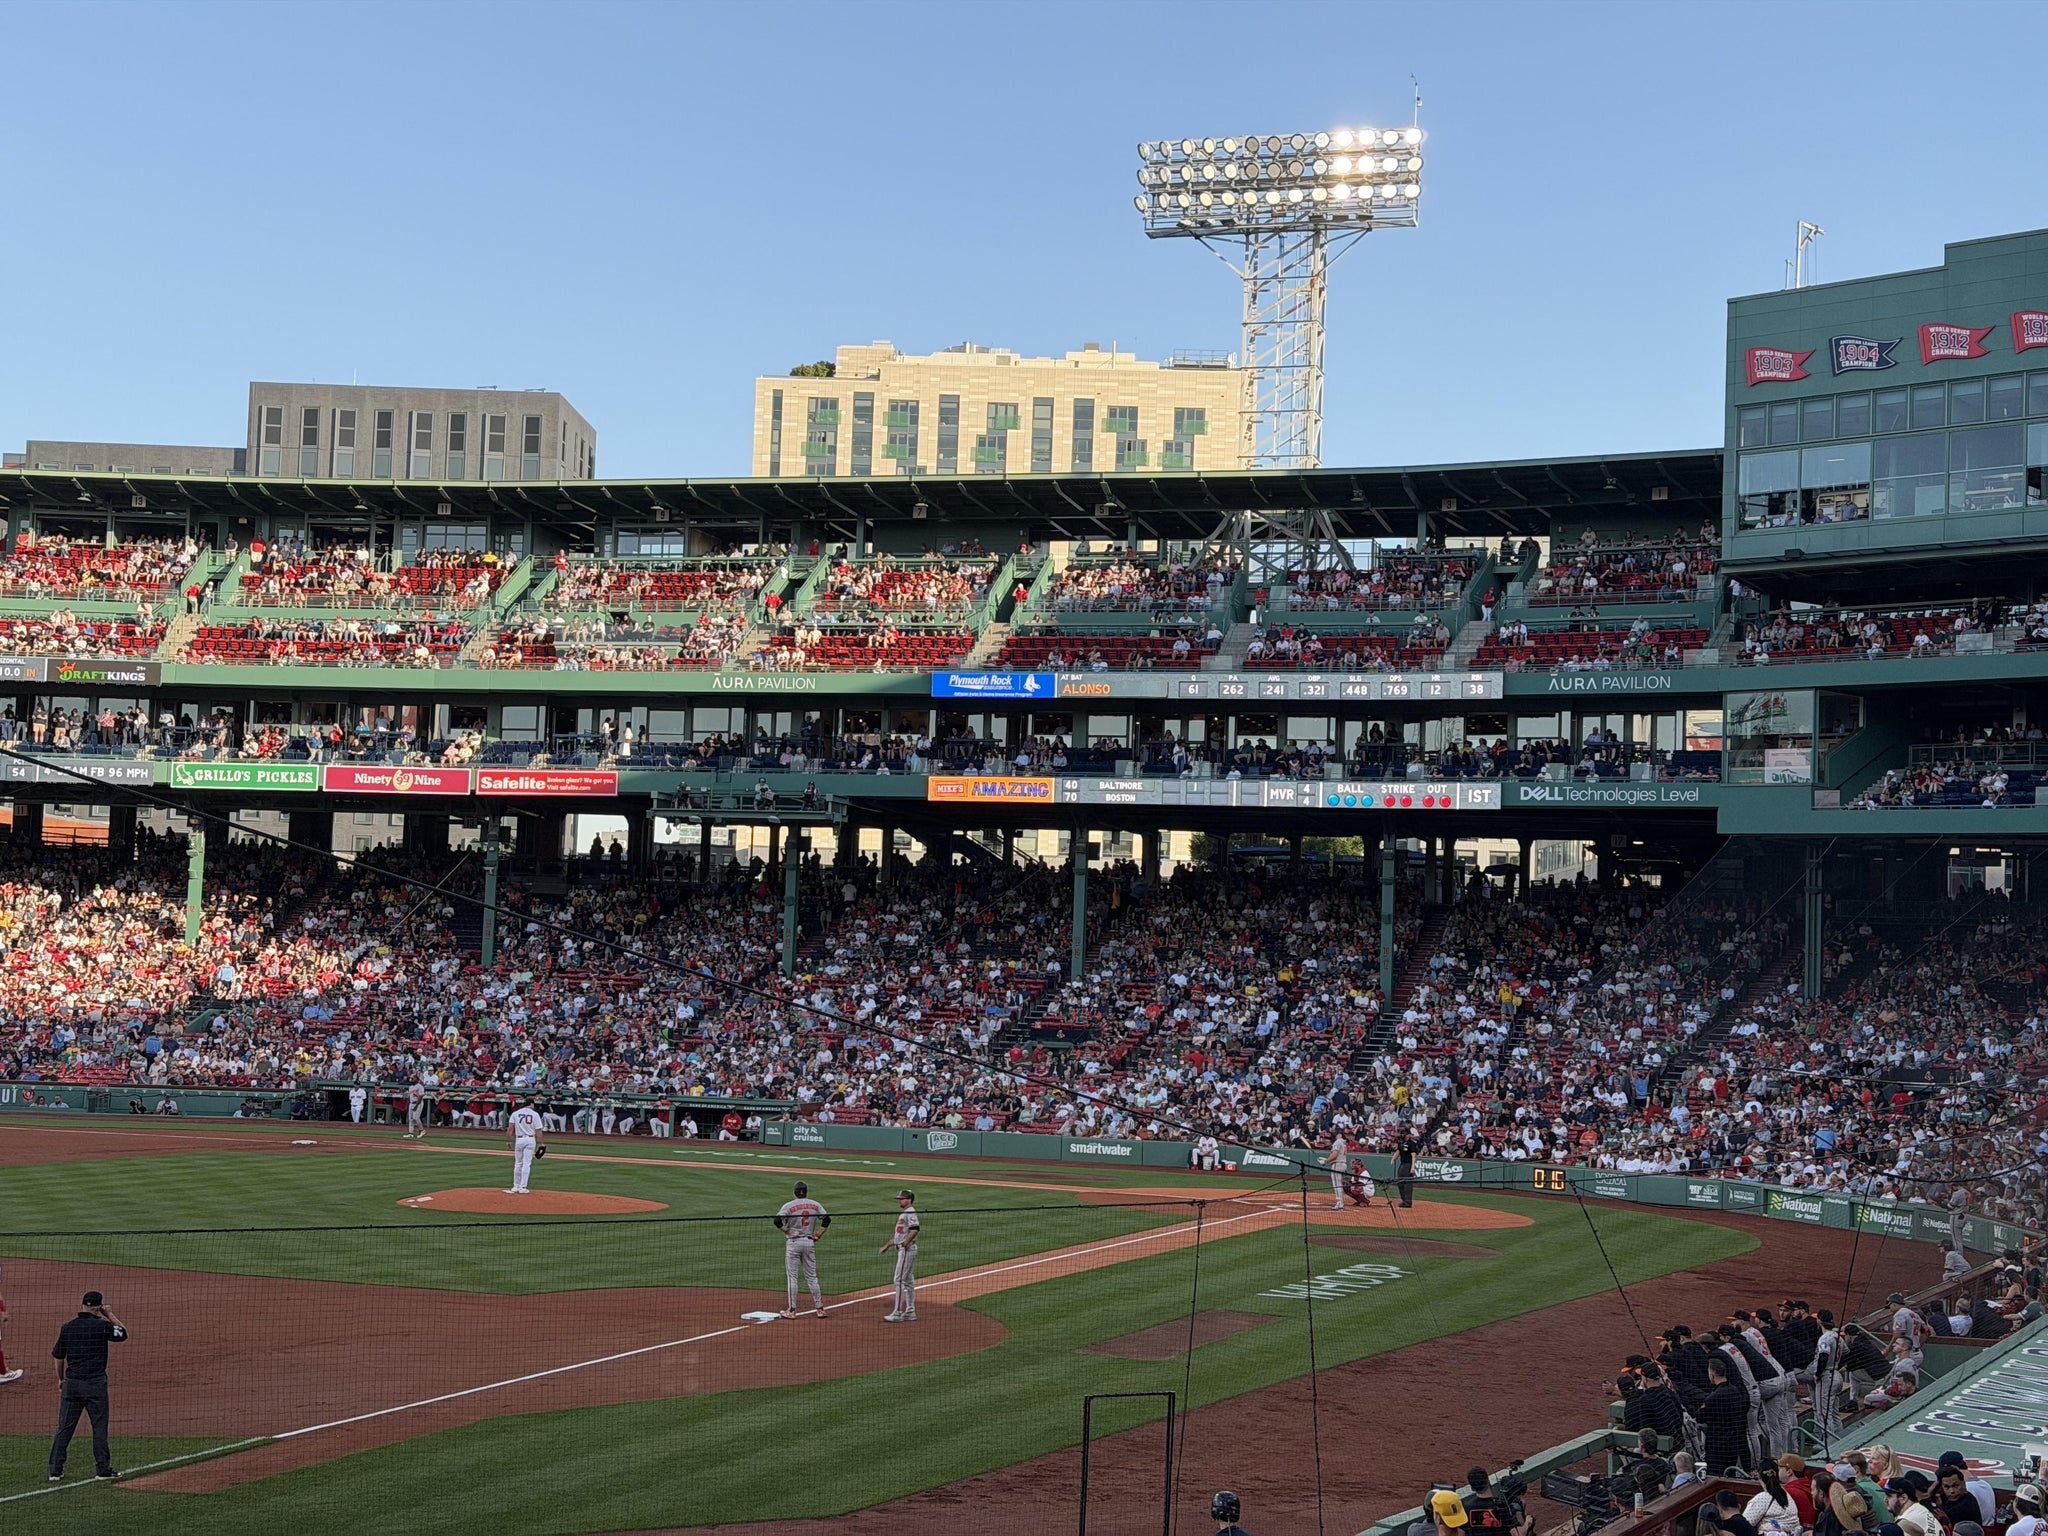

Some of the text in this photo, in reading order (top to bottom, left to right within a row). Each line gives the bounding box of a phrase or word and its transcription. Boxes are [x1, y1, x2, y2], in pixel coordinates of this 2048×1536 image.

[2023, 320, 2048, 338] 191
[1931, 332, 1970, 349] 1912
[1838, 344, 1880, 362] 1904
[1931, 348, 1969, 356] CHAMPIONS
[1754, 356, 1794, 373] 1903
[1756, 371, 1790, 379] CHAMPIONS
[26, 668, 36, 677] IN
[60, 669, 146, 681] DRAFTKINGS
[758, 677, 816, 690] PAVILION
[949, 674, 1013, 686] Plymouth Rock
[1602, 676, 1671, 689] PAVILION
[1062, 684, 1111, 695] ALONSO
[1188, 685, 1199, 695] 61
[1223, 685, 1244, 695] 262
[1262, 685, 1284, 695] .241
[1303, 685, 1325, 696] .321
[1342, 686, 1368, 696] .448
[1383, 685, 1408, 696] .769
[1430, 685, 1441, 695] 12
[1469, 685, 1484, 695] 38
[91, 767, 104, 777] FB
[108, 768, 122, 777] 96
[126, 769, 148, 778] MPH
[195, 770, 313, 783] GRILLO'S PICKLES
[354, 773, 392, 786] Ninety
[415, 775, 441, 786] Nine
[480, 776, 546, 790] Safelite
[936, 785, 964, 793] MIKE'S
[971, 782, 1049, 797] AMAZING
[1065, 781, 1078, 790] 40
[1099, 781, 1143, 790] BALTIMORE
[1303, 784, 1310, 793] 4
[1337, 784, 1447, 794] BALL STRIKE OUT
[1065, 792, 1136, 802] 70 BOSTON
[1269, 788, 1294, 800] MVR
[1520, 786, 1699, 804] DELL Technologies Level
[518, 1114, 533, 1125] 70
[794, 1126, 809, 1136] city
[1070, 1142, 1132, 1156] smartwater
[1782, 1196, 1822, 1214] National
